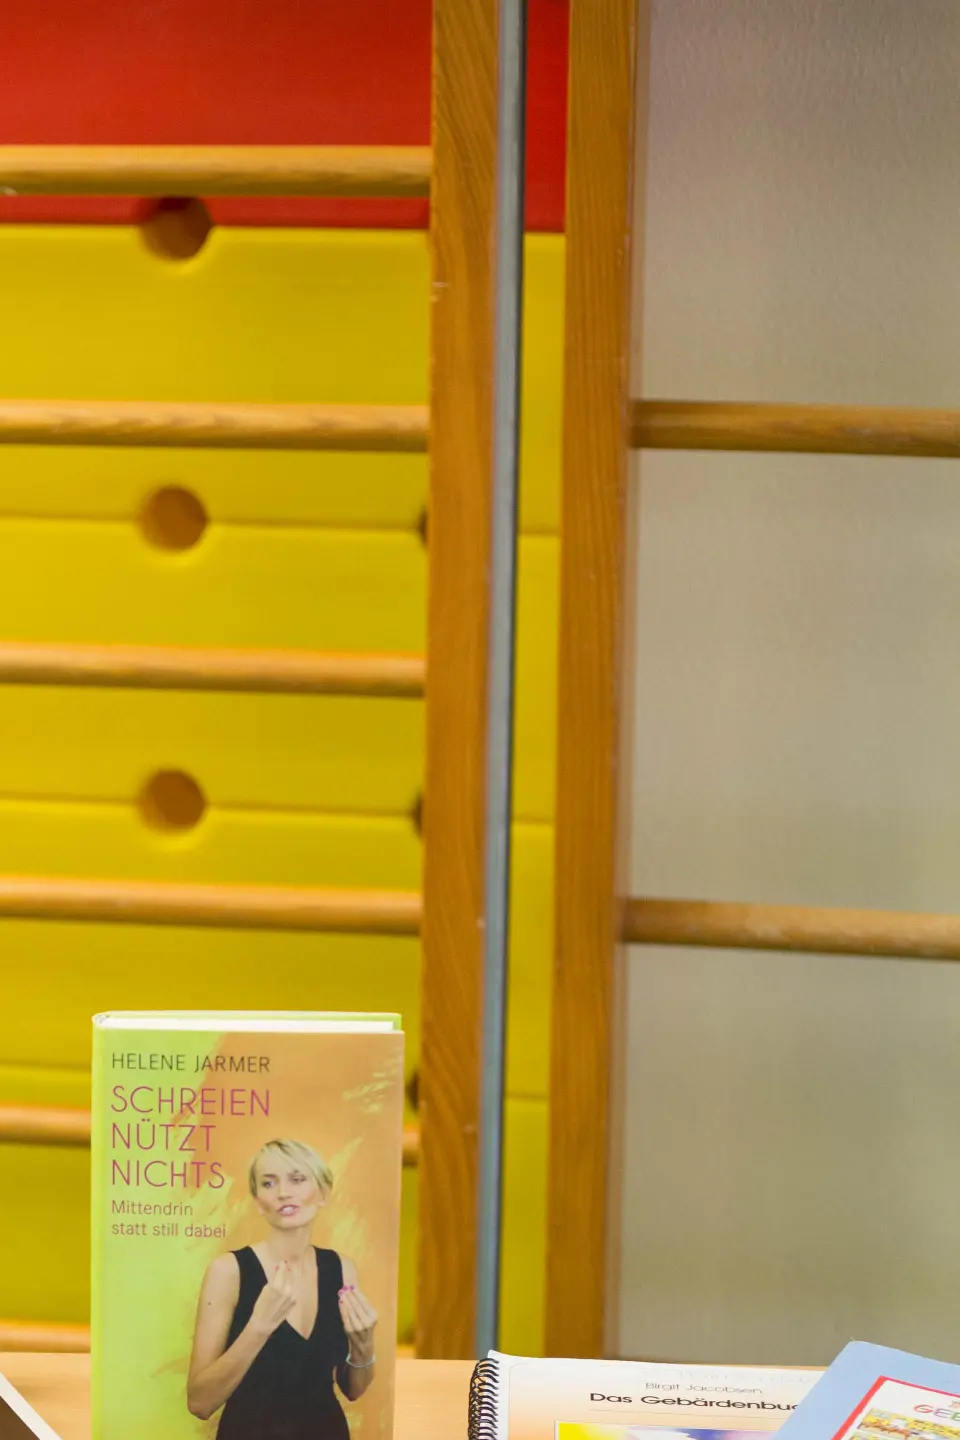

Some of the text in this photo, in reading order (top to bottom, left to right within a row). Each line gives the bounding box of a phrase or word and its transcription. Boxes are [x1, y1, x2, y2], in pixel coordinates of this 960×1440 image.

[111, 1053, 271, 1073] HELENE JARMER
[110, 1085, 270, 1117] SCHREIEN
[111, 1118, 217, 1152] NÜTZT
[111, 1159, 226, 1189] NICHTS
[111, 1200, 194, 1216] Mittendrin
[111, 1222, 227, 1238] statt still dabei
[645, 1382, 763, 1395] Birgit Jacobsen
[590, 1392, 799, 1411] Das Gebärdenbuc
